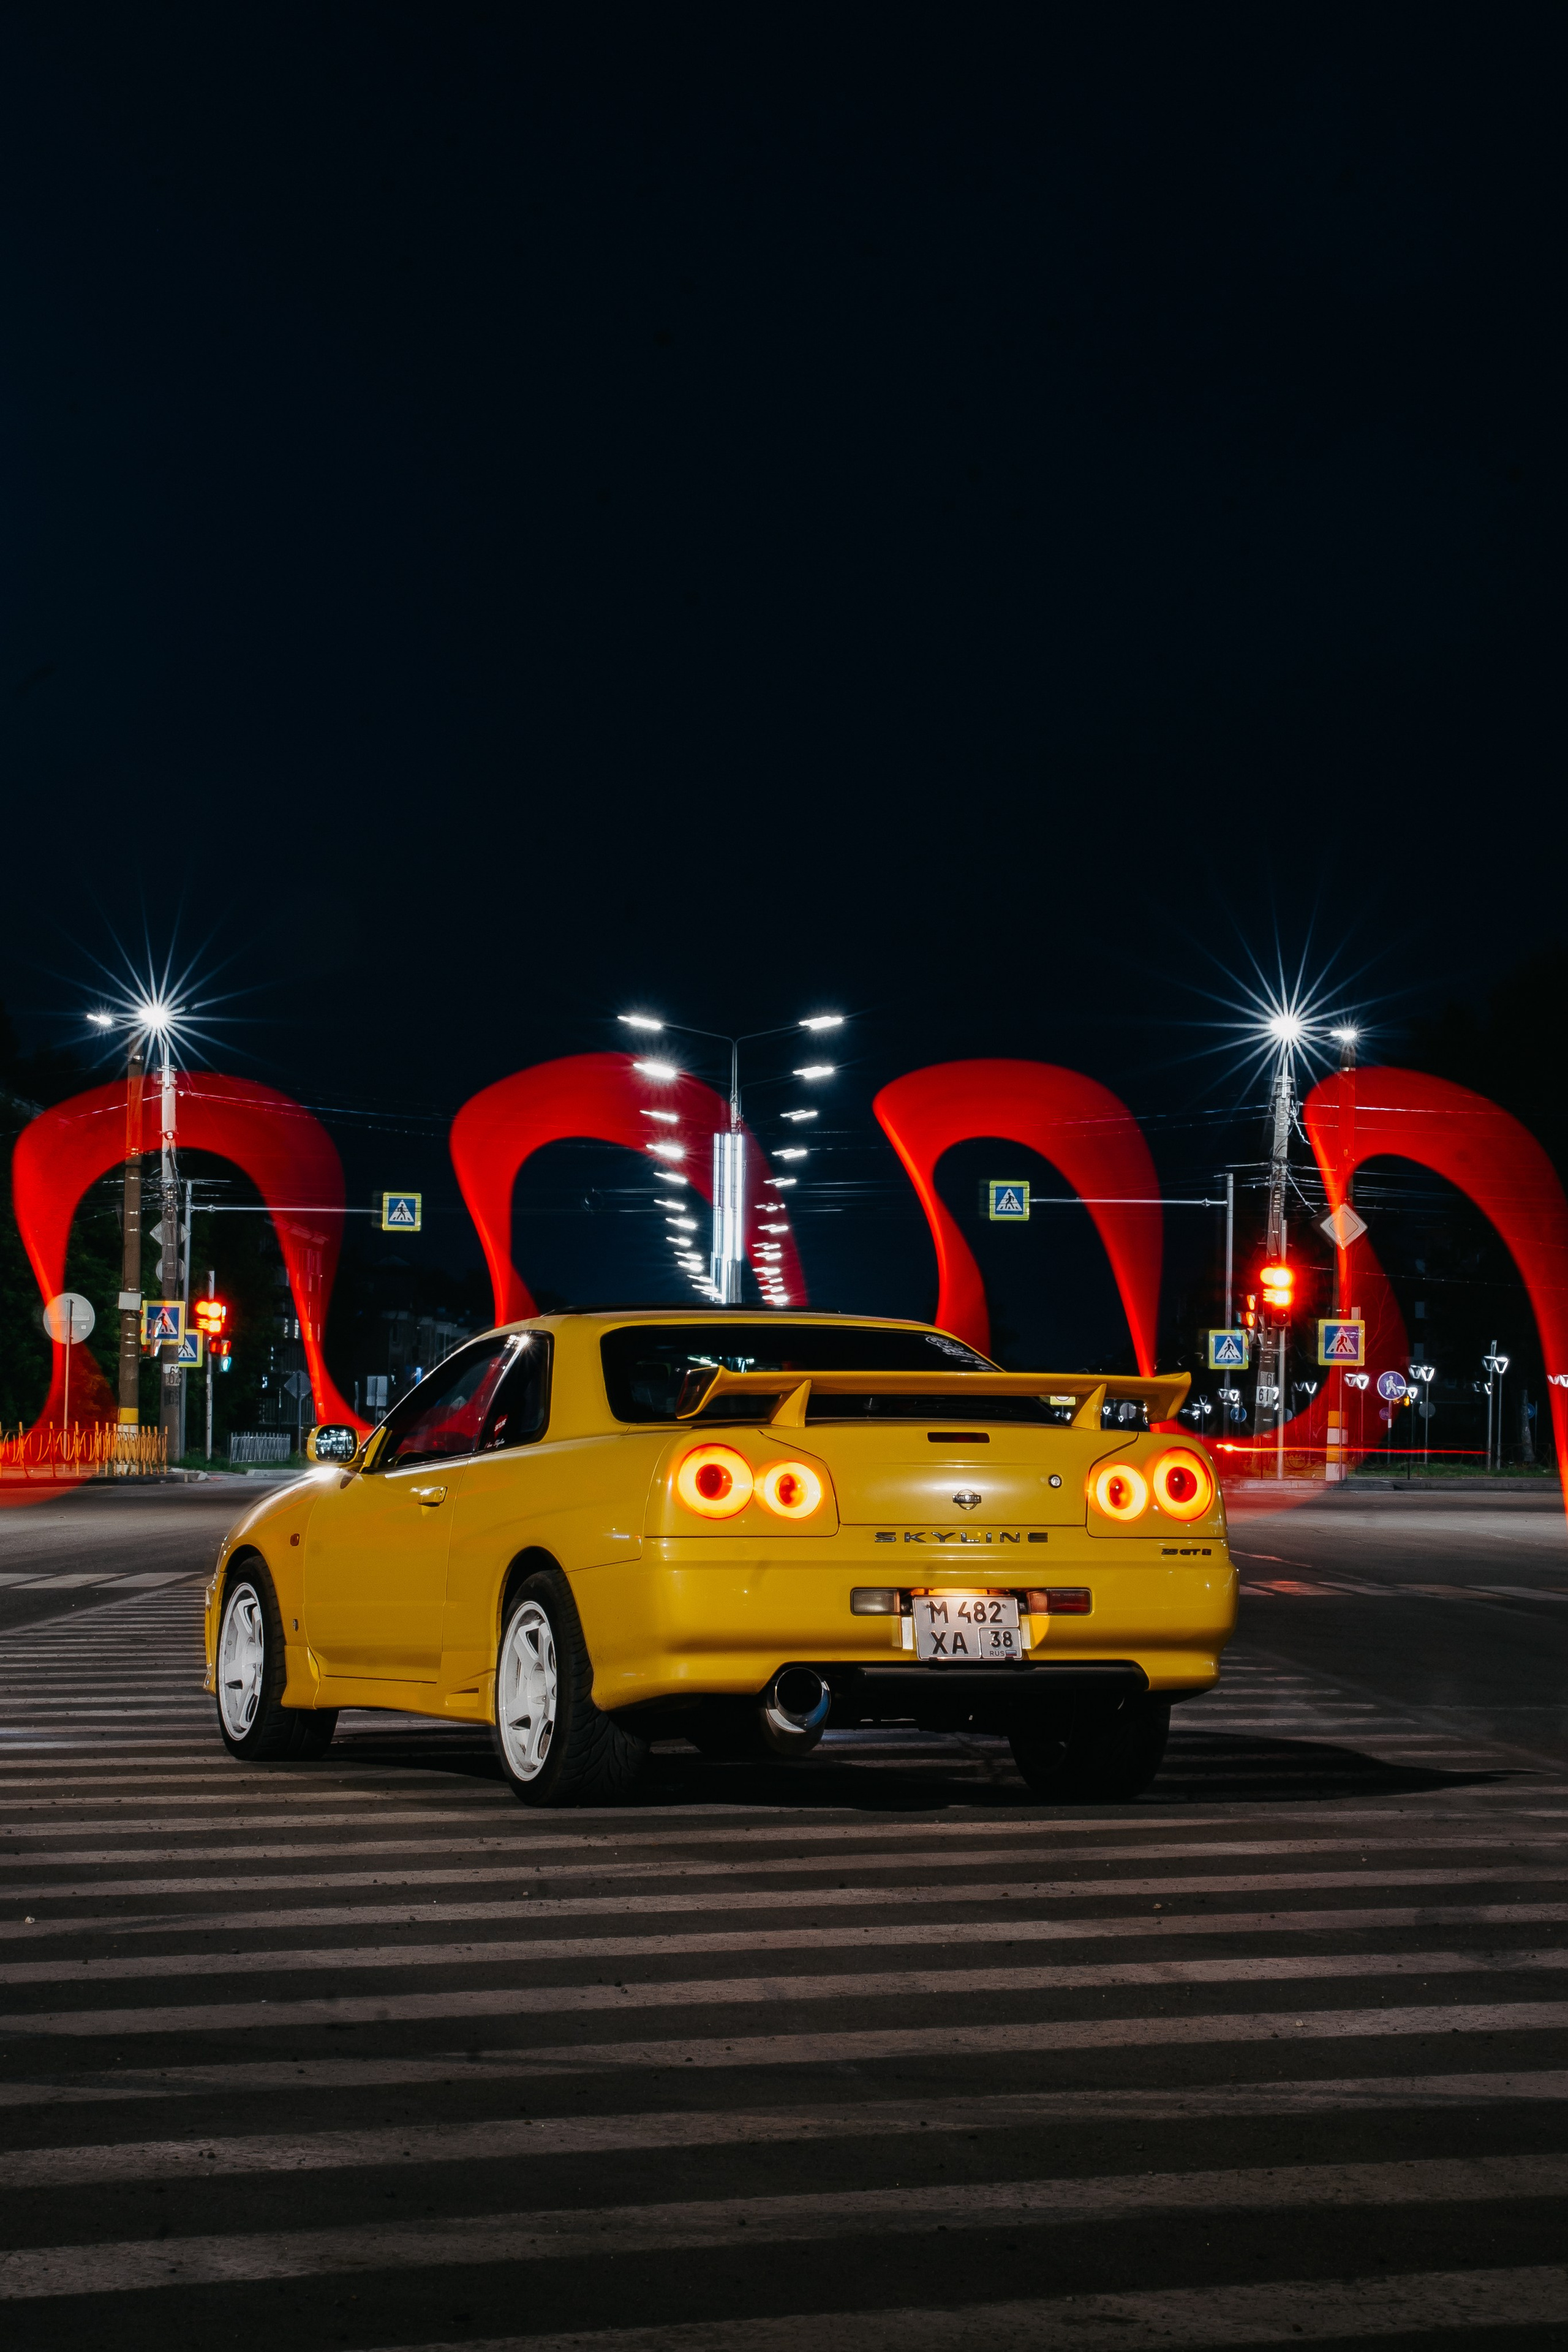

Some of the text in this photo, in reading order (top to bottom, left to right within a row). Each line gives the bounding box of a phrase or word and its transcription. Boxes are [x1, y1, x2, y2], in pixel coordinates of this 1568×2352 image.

[1259, 1388, 1268, 1401] 61
[875, 1532, 1048, 1543] SKYLINE
[957, 1601, 1003, 1624] 482
[989, 1631, 1012, 1648] 38
